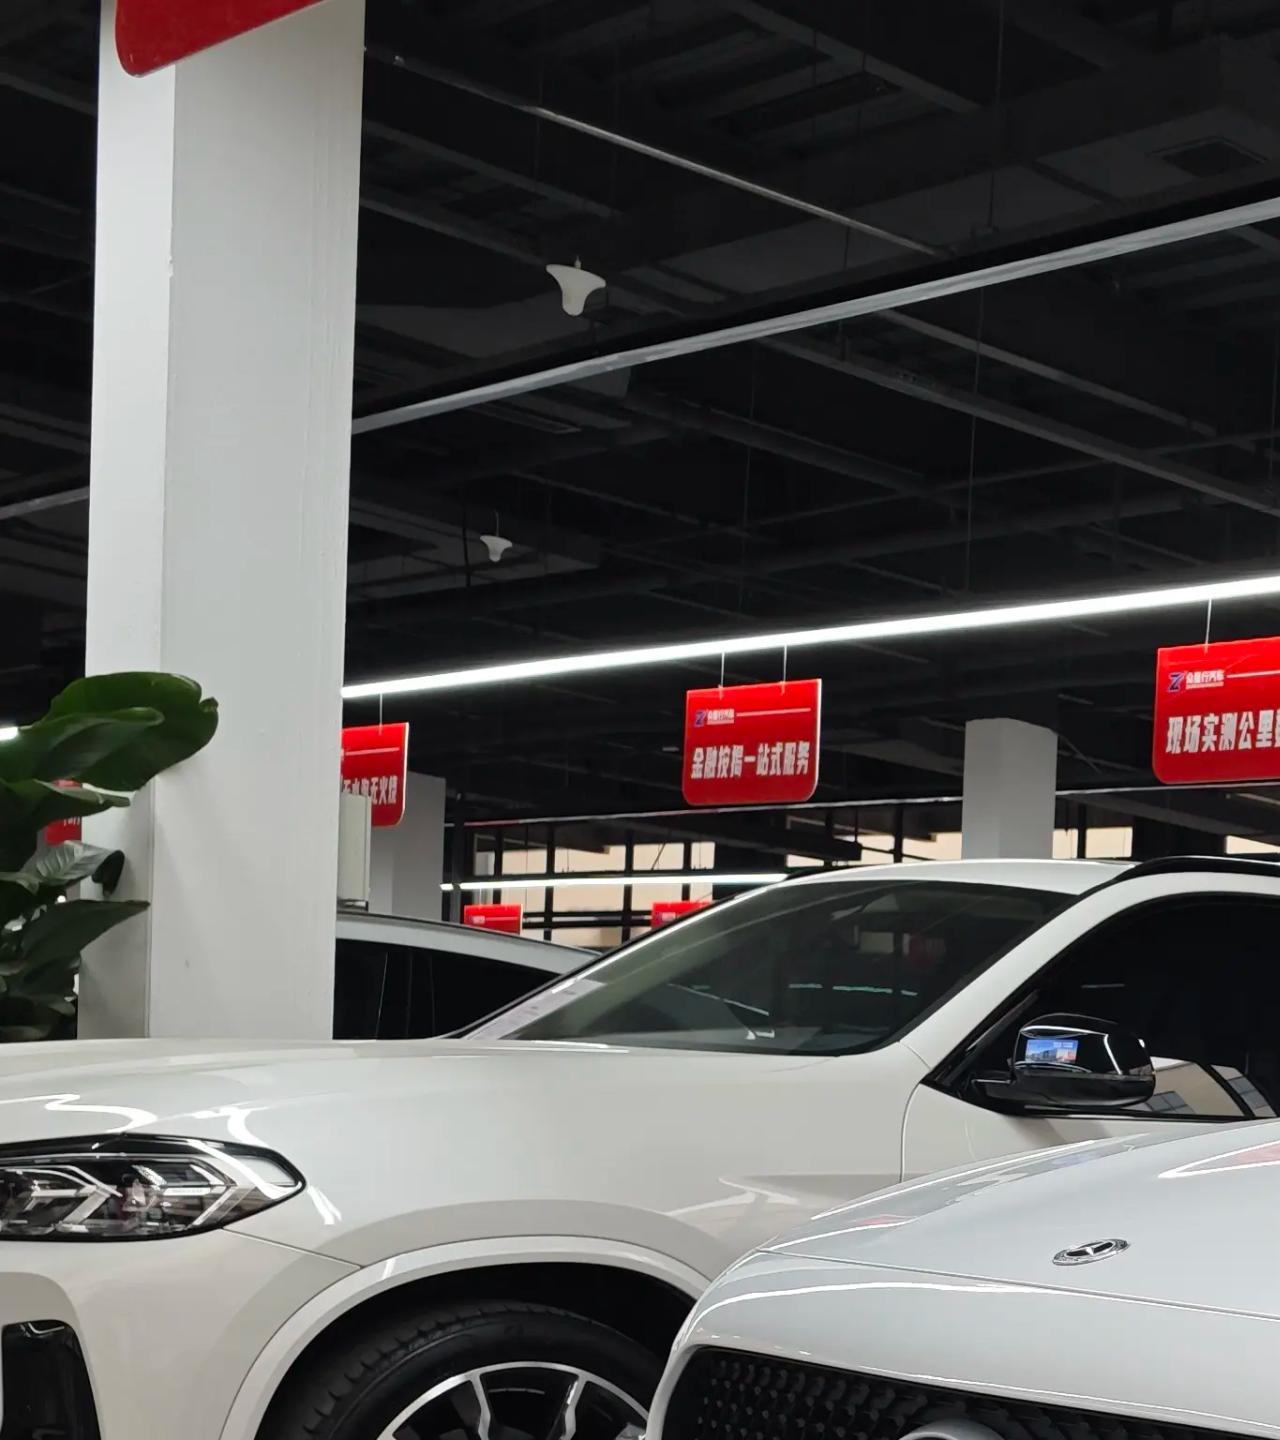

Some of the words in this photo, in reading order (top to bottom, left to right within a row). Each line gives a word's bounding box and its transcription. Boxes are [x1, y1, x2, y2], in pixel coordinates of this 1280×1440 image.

[692, 741, 810, 779] 金融按揭一站式服务
